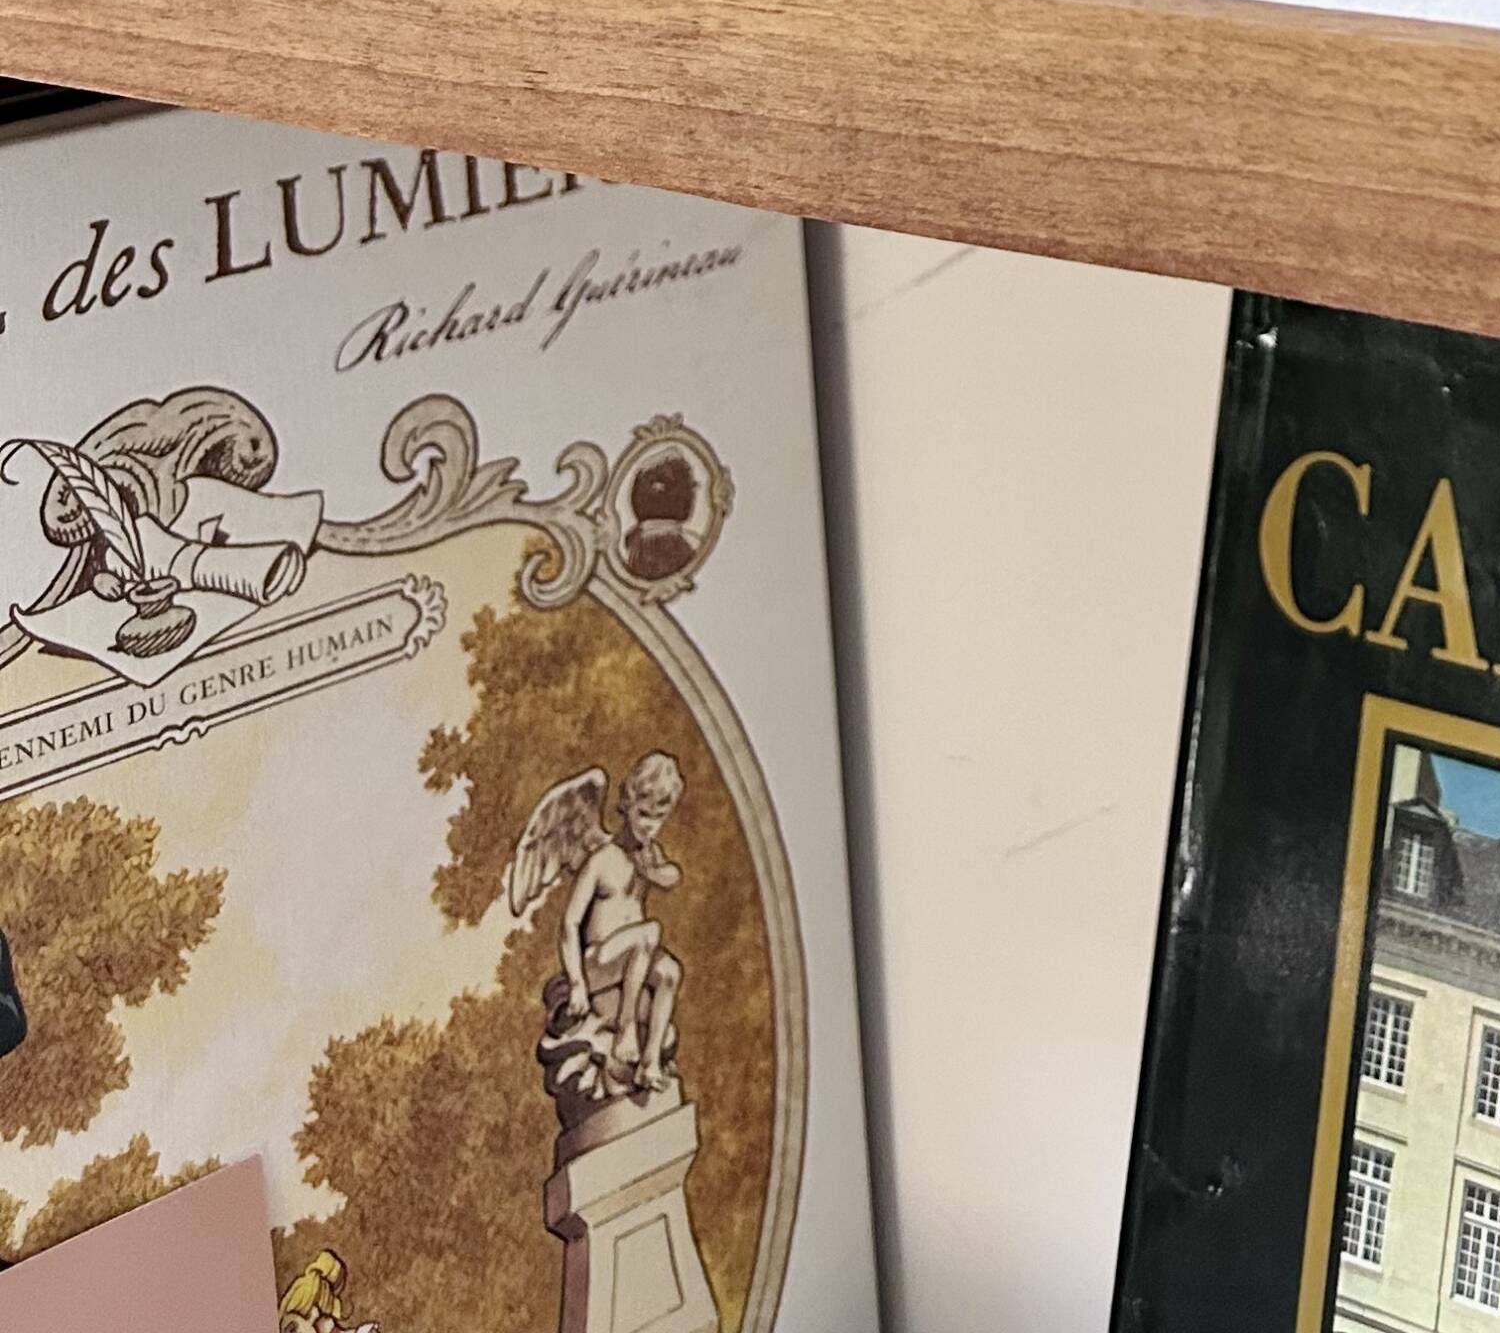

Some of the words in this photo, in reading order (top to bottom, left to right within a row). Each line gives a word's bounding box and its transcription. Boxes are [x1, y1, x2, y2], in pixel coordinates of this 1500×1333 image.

[42, 218, 174, 322] des
[204, 147, 622, 284] LUMIE
[335, 268, 551, 373] Richard
[0, 712, 114, 771] ENNEMI
[126, 692, 168, 727] DU
[179, 656, 277, 706] GENRE
[286, 613, 394, 671] HUMAIN
